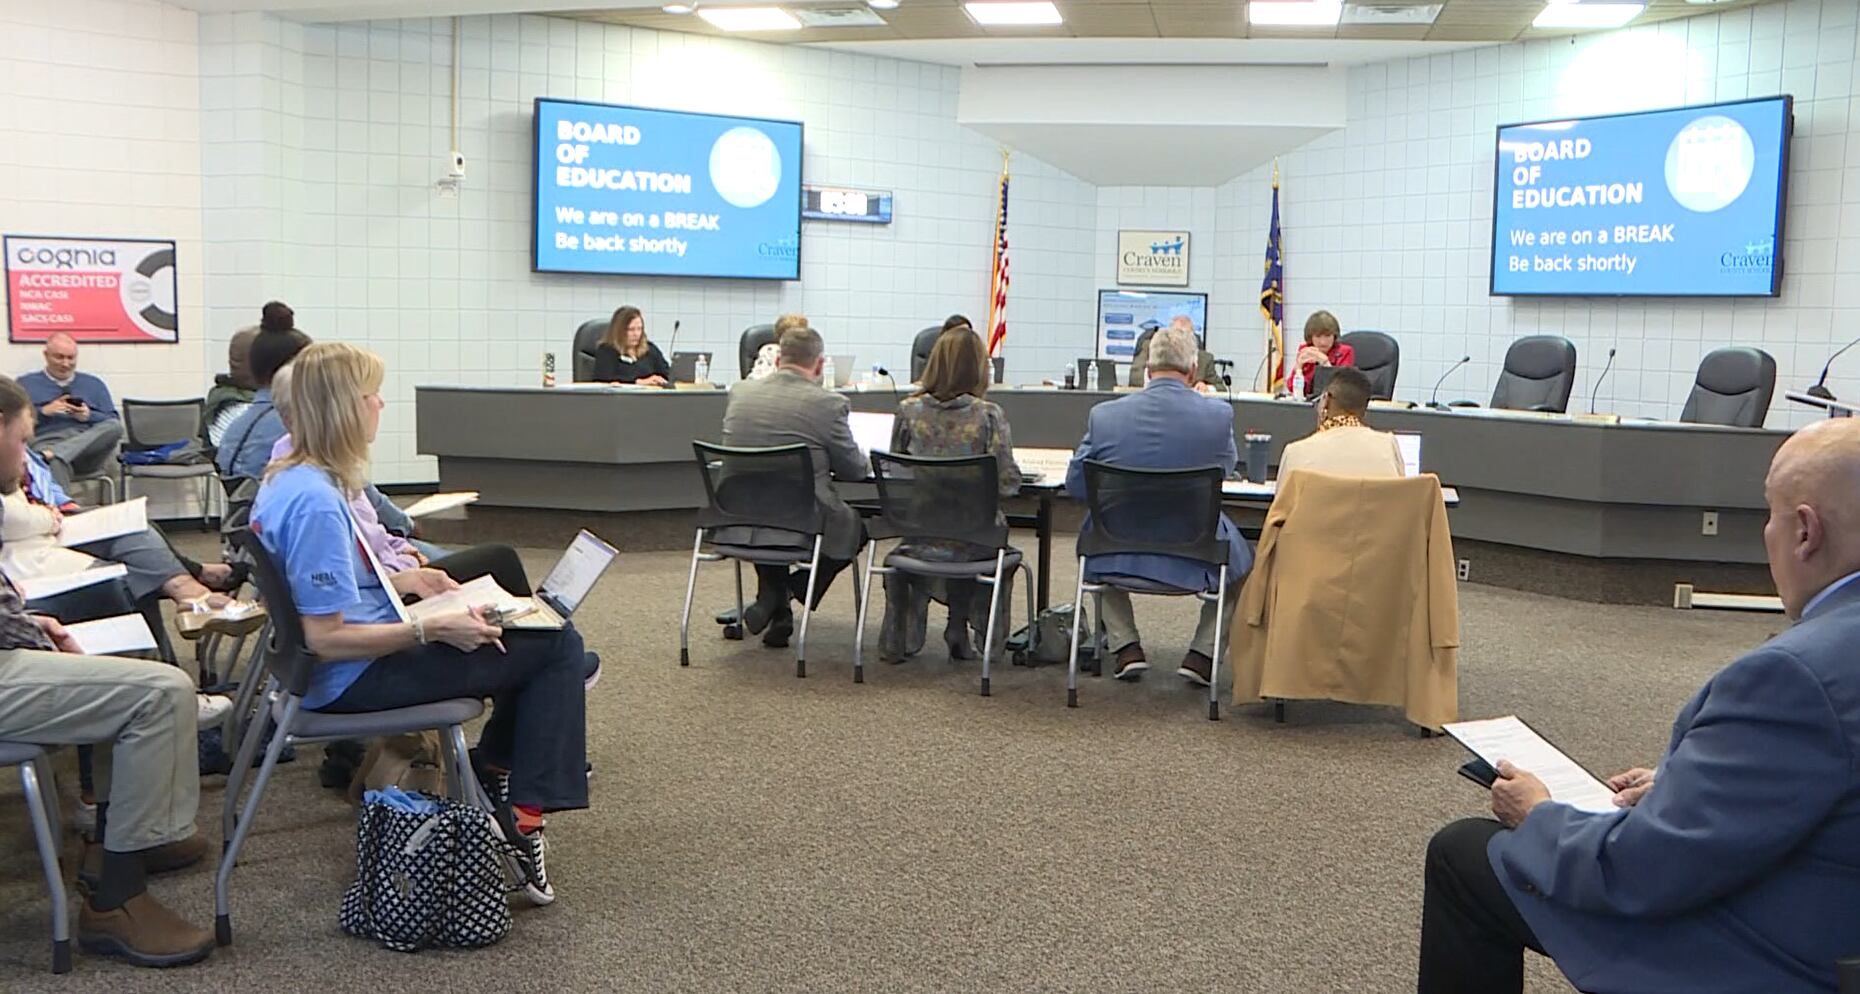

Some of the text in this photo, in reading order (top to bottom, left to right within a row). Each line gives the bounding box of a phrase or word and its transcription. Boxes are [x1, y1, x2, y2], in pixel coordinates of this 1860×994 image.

[557, 120, 641, 145] BOARD
[556, 143, 590, 164] OF
[1514, 138, 1592, 163] BOARD
[556, 166, 692, 193] EDUCATION
[1512, 165, 1541, 186] OF
[1512, 181, 1643, 209] EDUCATION
[555, 206, 720, 231] We are on a BREAK
[555, 232, 687, 257] Be back shortly
[1510, 223, 1675, 246] We are on a BREAK
[18, 247, 116, 269] cognia
[1123, 251, 1181, 268] Craven
[1509, 253, 1637, 275] Be back shortly
[20, 274, 118, 288] ACCREDITED
